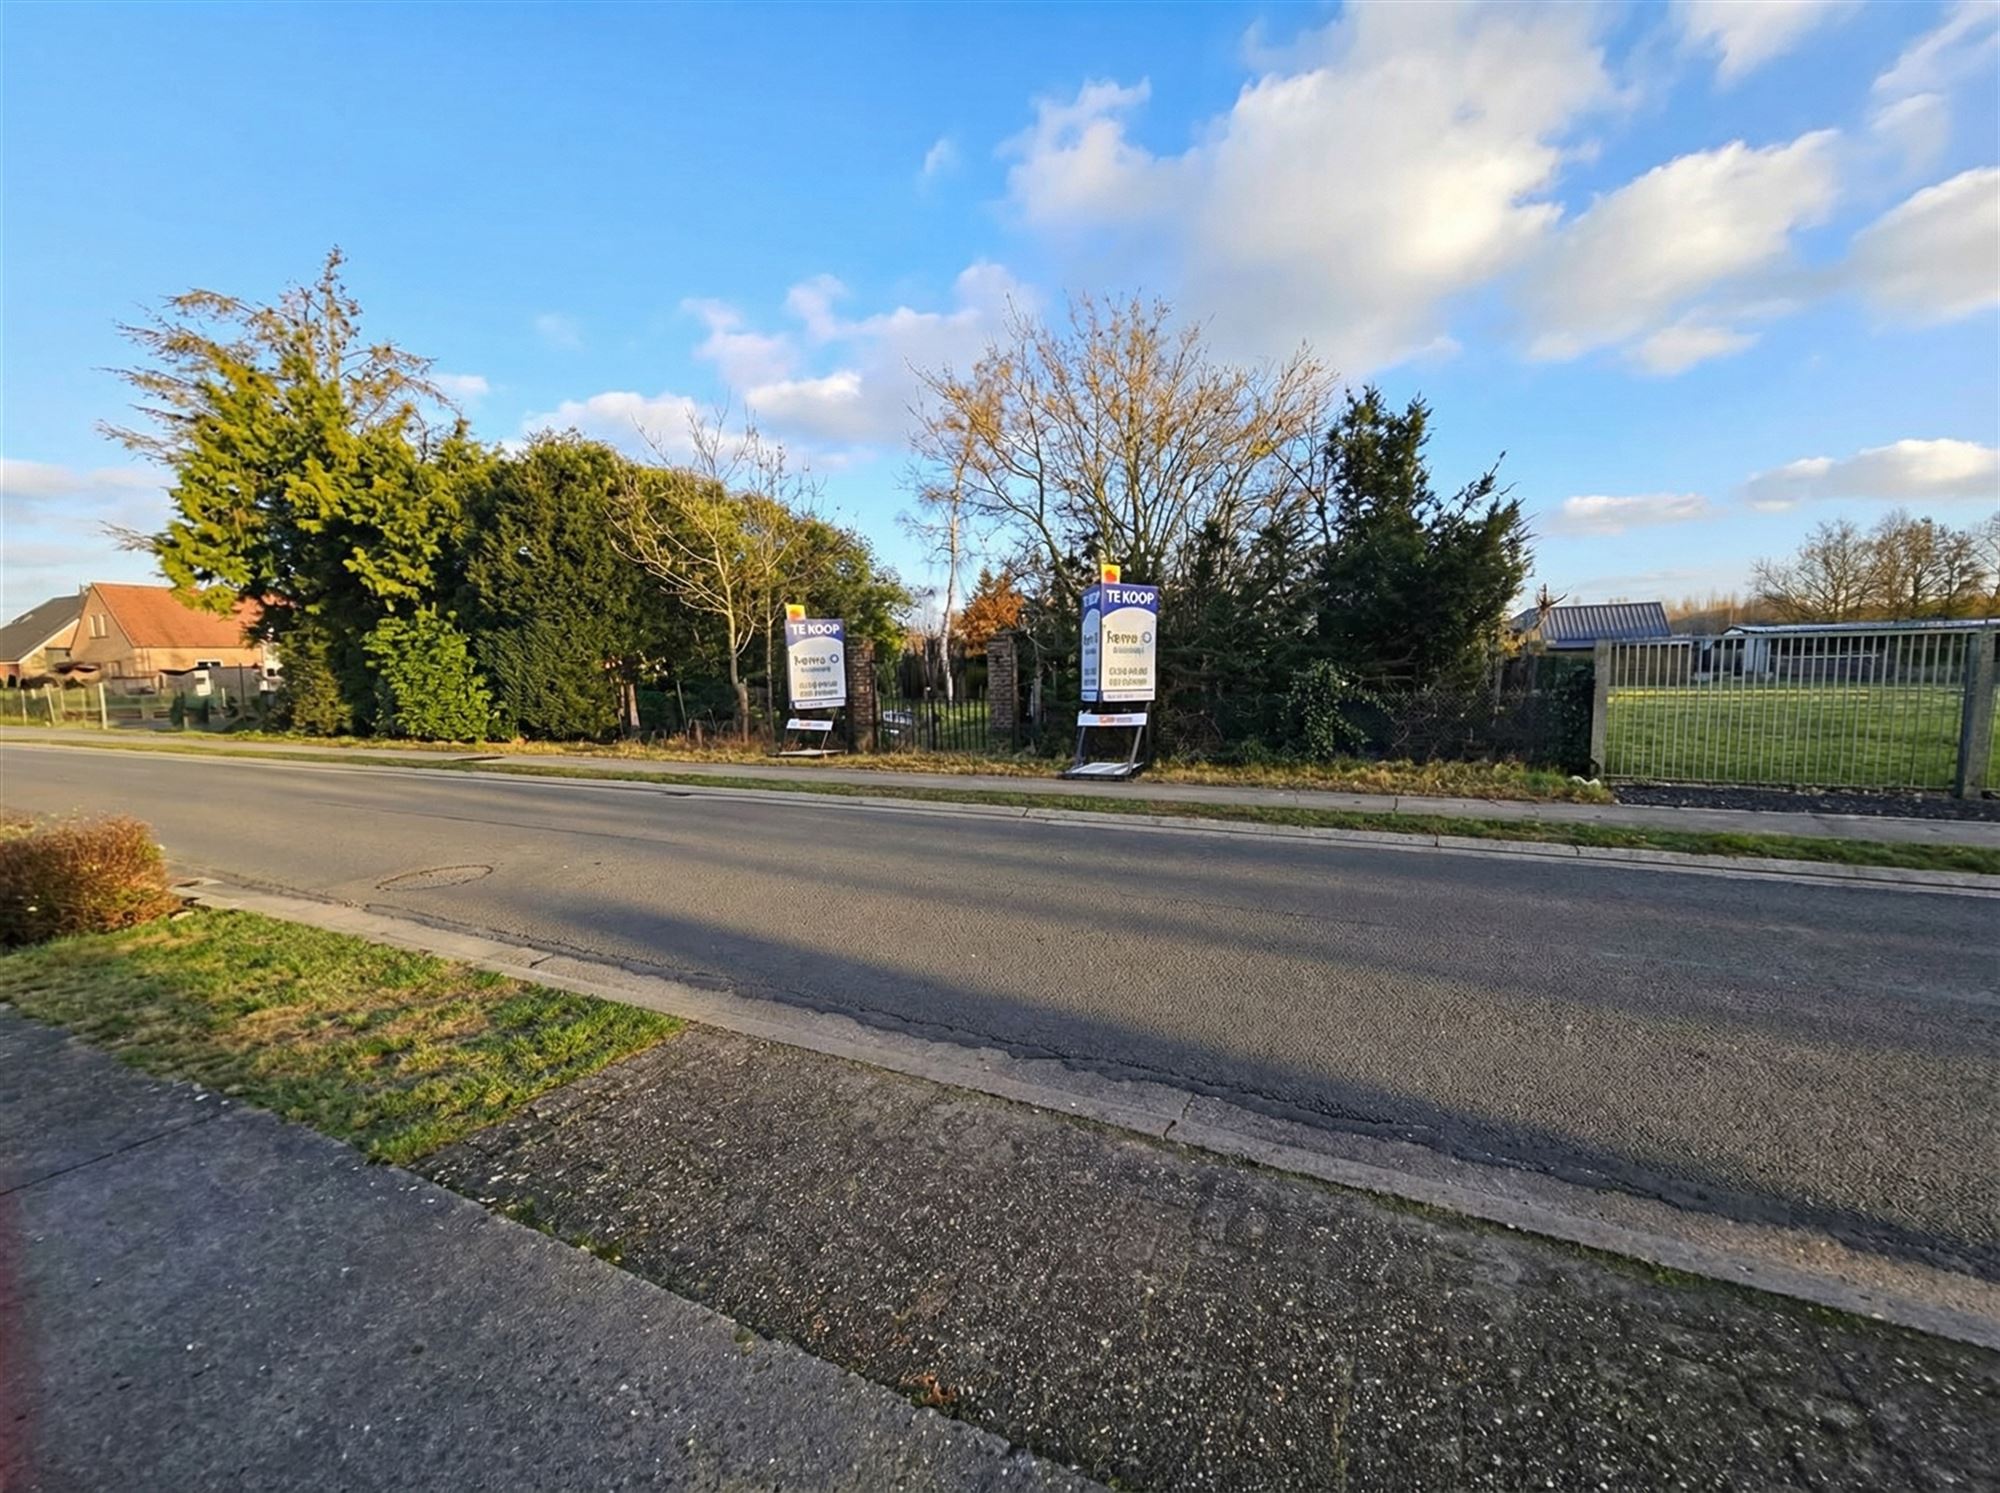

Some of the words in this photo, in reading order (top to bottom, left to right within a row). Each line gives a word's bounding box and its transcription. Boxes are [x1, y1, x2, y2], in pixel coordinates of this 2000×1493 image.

[1106, 589, 1121, 603] TE
[1122, 590, 1155, 605] KOOP
[790, 624, 806, 635] TE
[808, 624, 840, 635] KOOP
